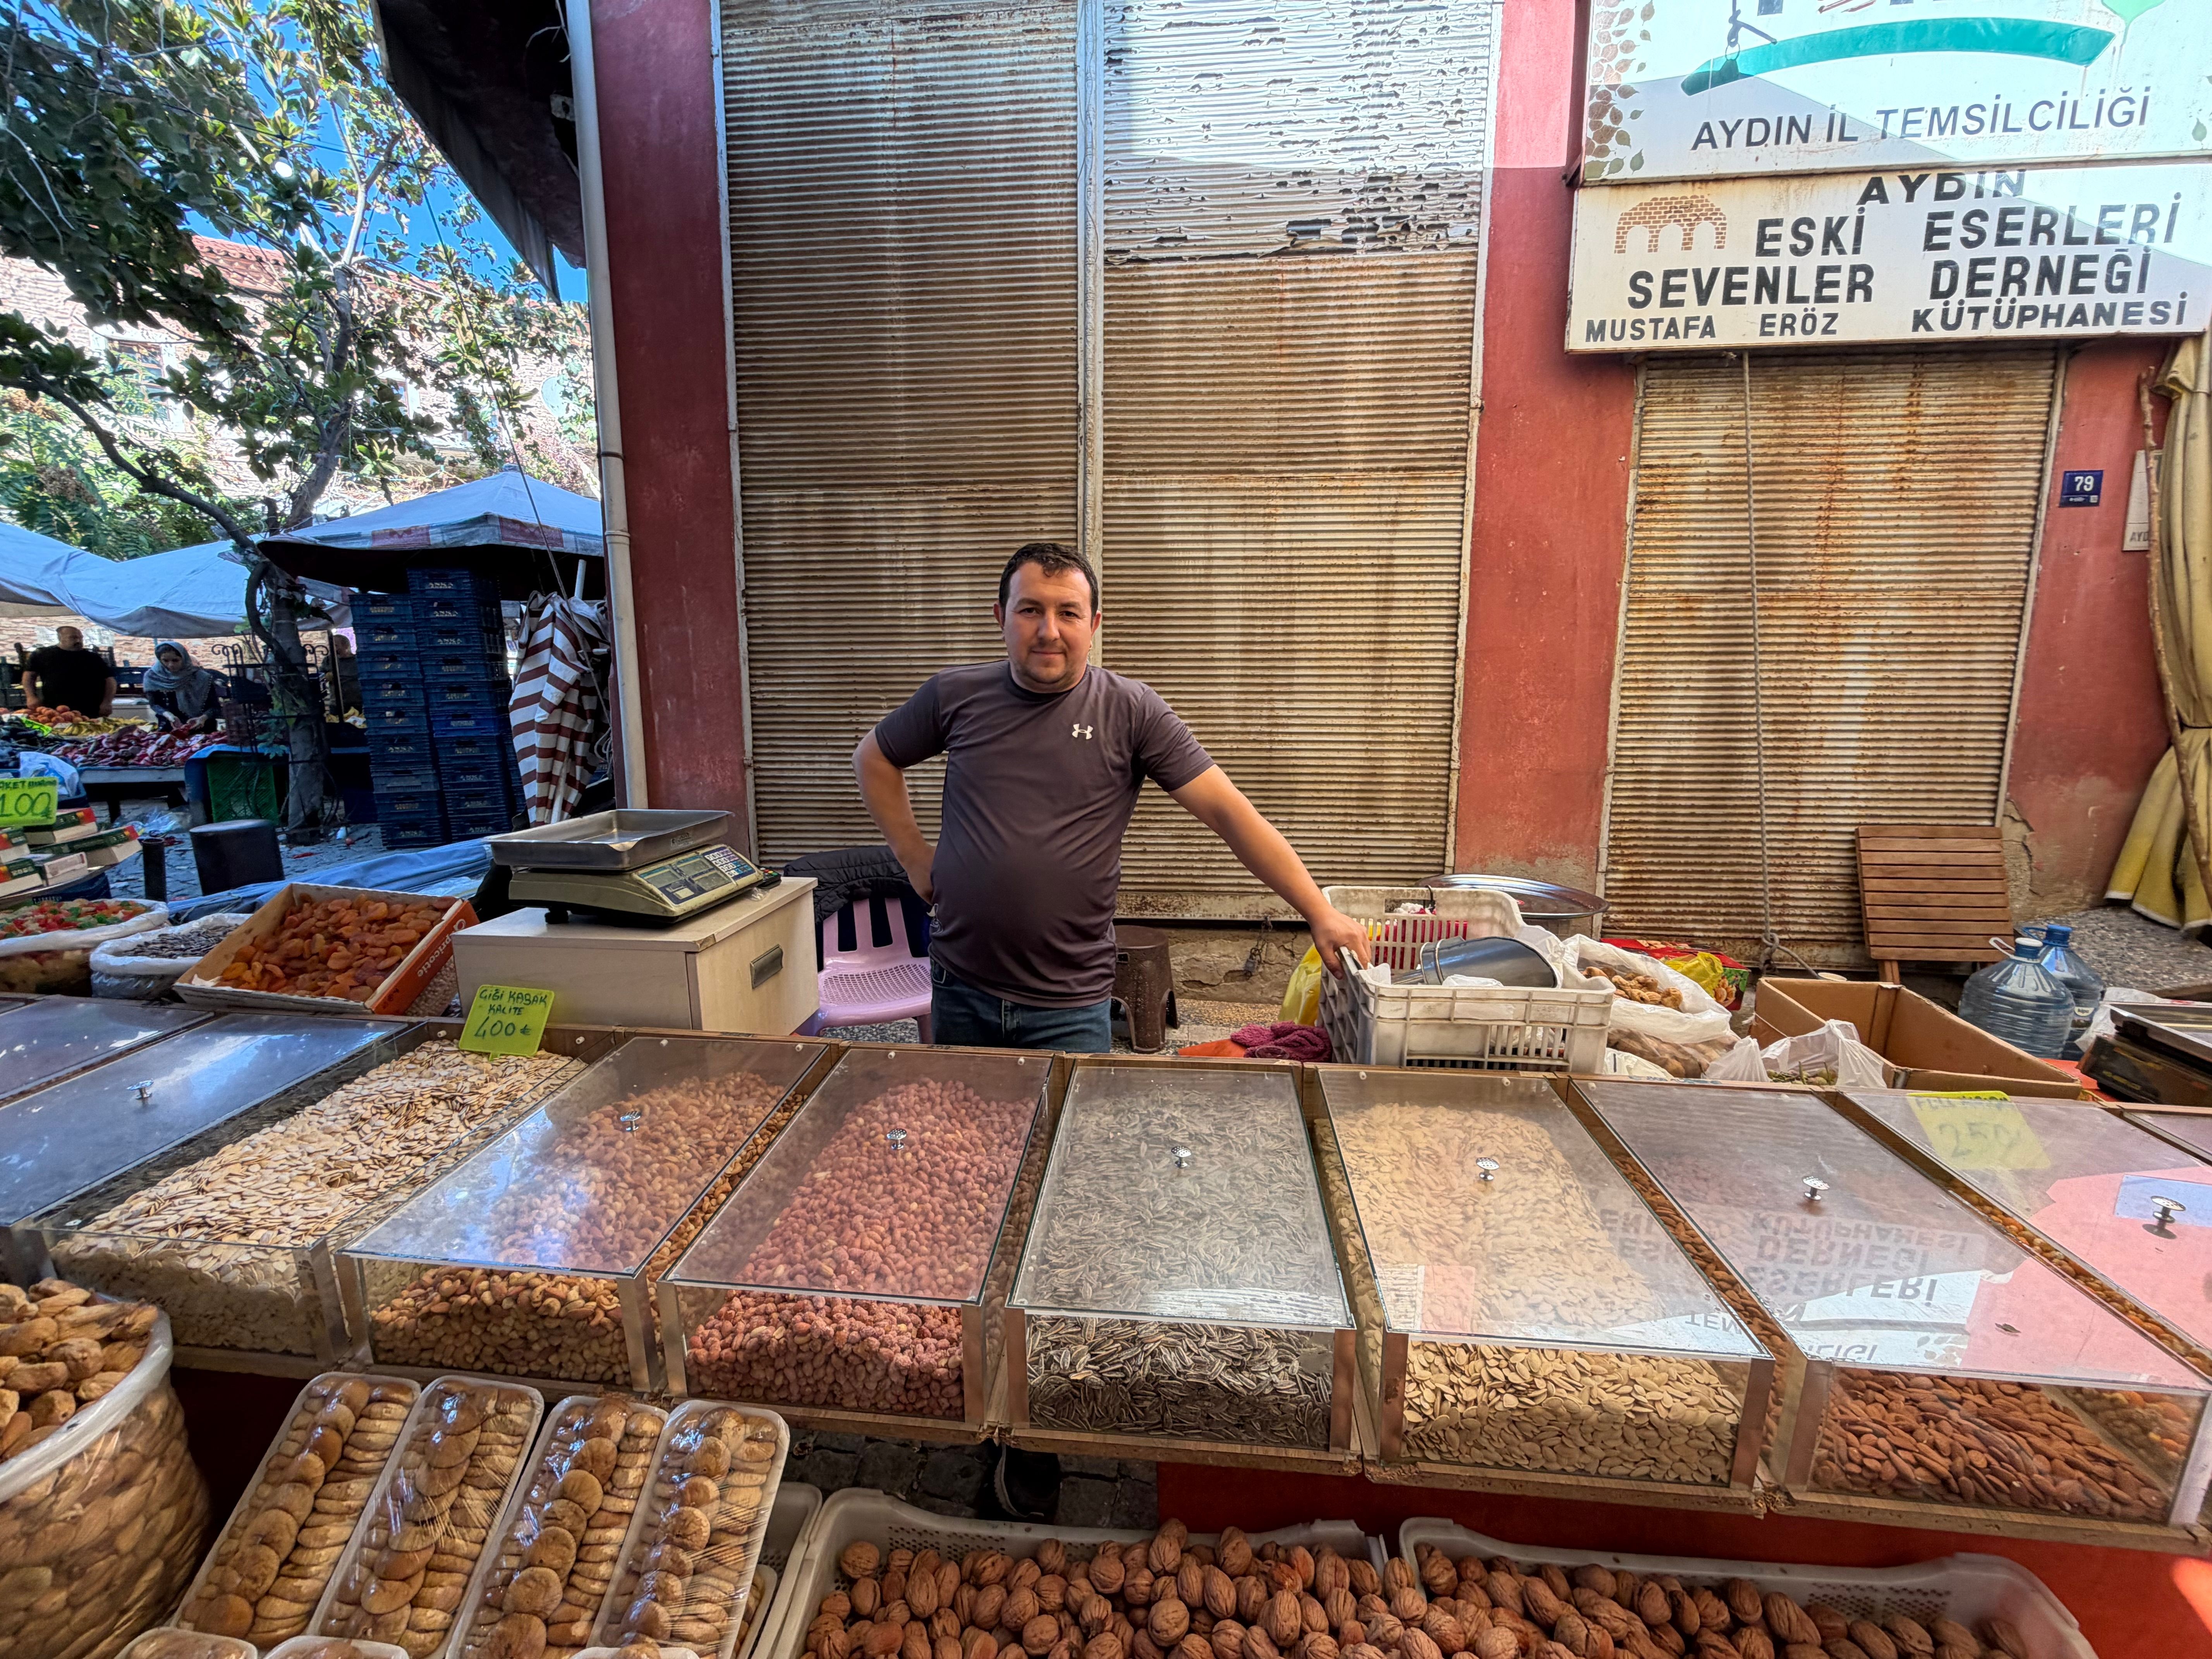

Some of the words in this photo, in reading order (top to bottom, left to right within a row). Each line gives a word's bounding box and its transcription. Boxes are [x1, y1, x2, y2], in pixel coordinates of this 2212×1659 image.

[1690, 114, 1812, 151] AYDIN
[1826, 104, 1858, 143] İL
[1876, 86, 2151, 140] TEMSİLCİLİĞİ
[1856, 169, 2027, 206] AYDIN
[1755, 207, 1865, 257] ESKİ
[1922, 192, 2181, 252] ESERLERİ
[1628, 264, 1874, 309] SEVENLER
[1929, 245, 2152, 300] DERNEĞİ
[1585, 315, 1716, 343] MUSTAFA
[1759, 307, 1839, 337] ERÖZ
[1911, 292, 2187, 333] KÜTÜPHANESİ
[2075, 476, 2094, 491] 79
[508, 991, 547, 1008] KABAK
[474, 1016, 515, 1039] 400
